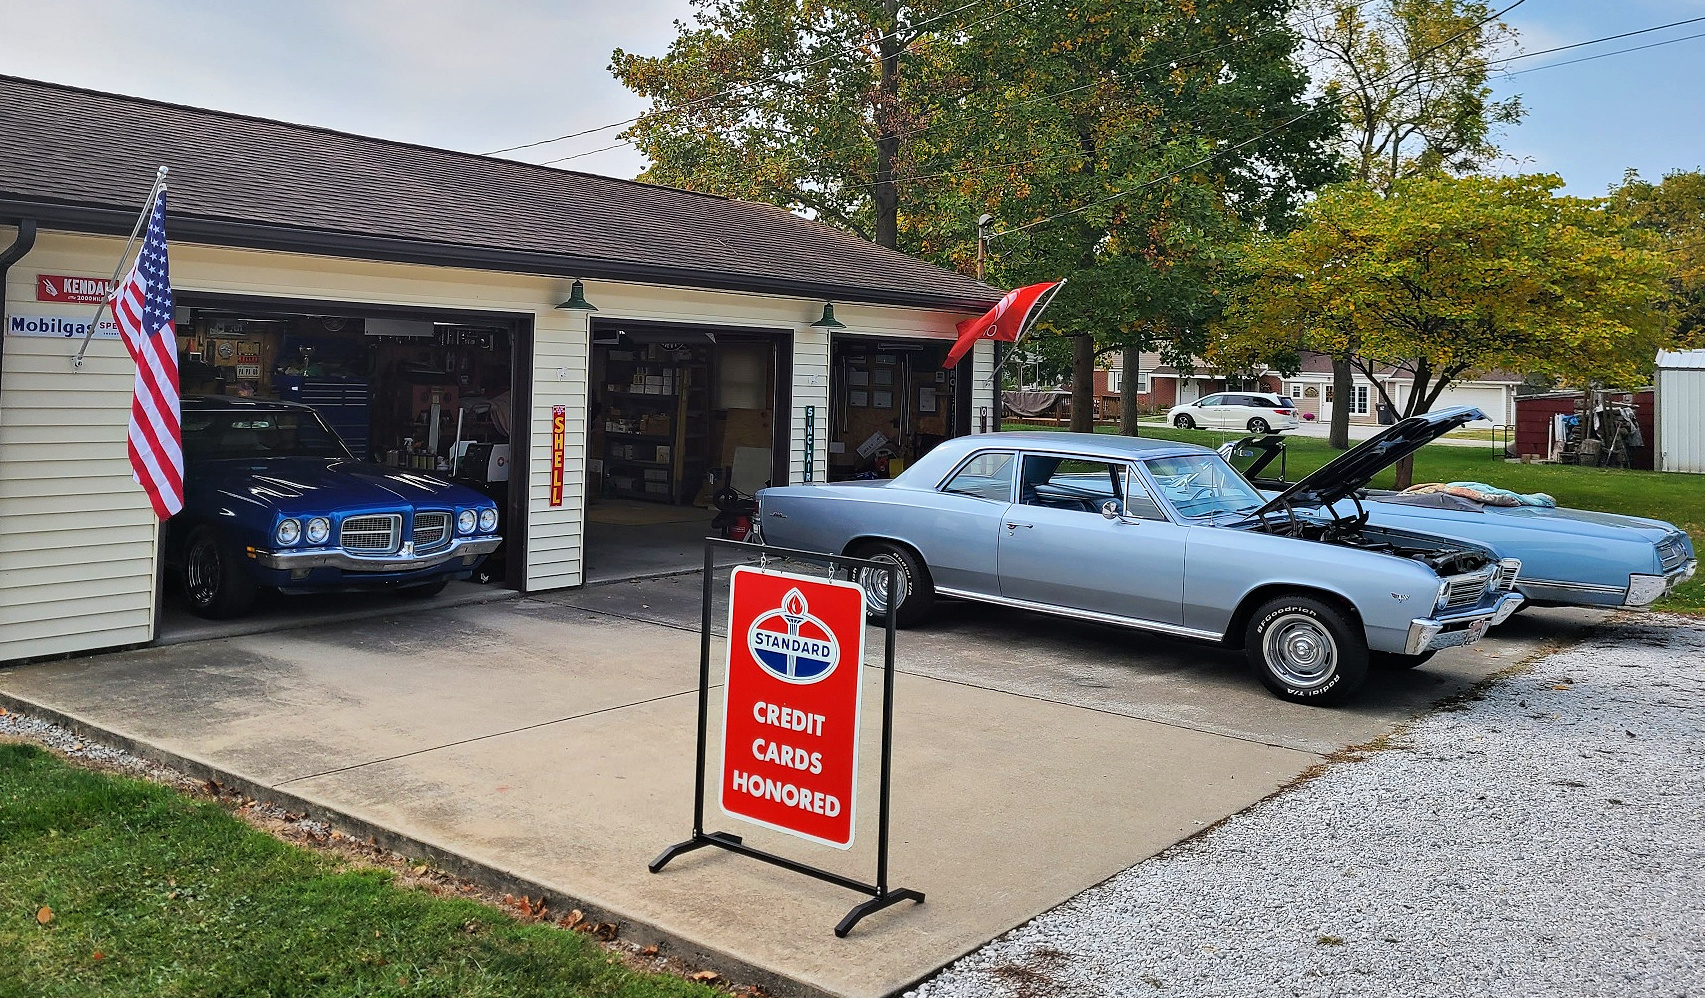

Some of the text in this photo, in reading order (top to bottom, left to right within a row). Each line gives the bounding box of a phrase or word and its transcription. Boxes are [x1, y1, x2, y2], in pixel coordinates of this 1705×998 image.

[63, 278, 109, 296] KENDA
[552, 416, 565, 504] SHELL
[805, 407, 814, 482] SINCLAIR
[1256, 606, 1317, 634] BFGoodrich
[755, 632, 831, 658] STANDARD
[1286, 674, 1341, 697] Radial T/A
[753, 701, 826, 737] CREDIT
[752, 738, 823, 775] CARDS
[732, 769, 841, 818] HONORED
